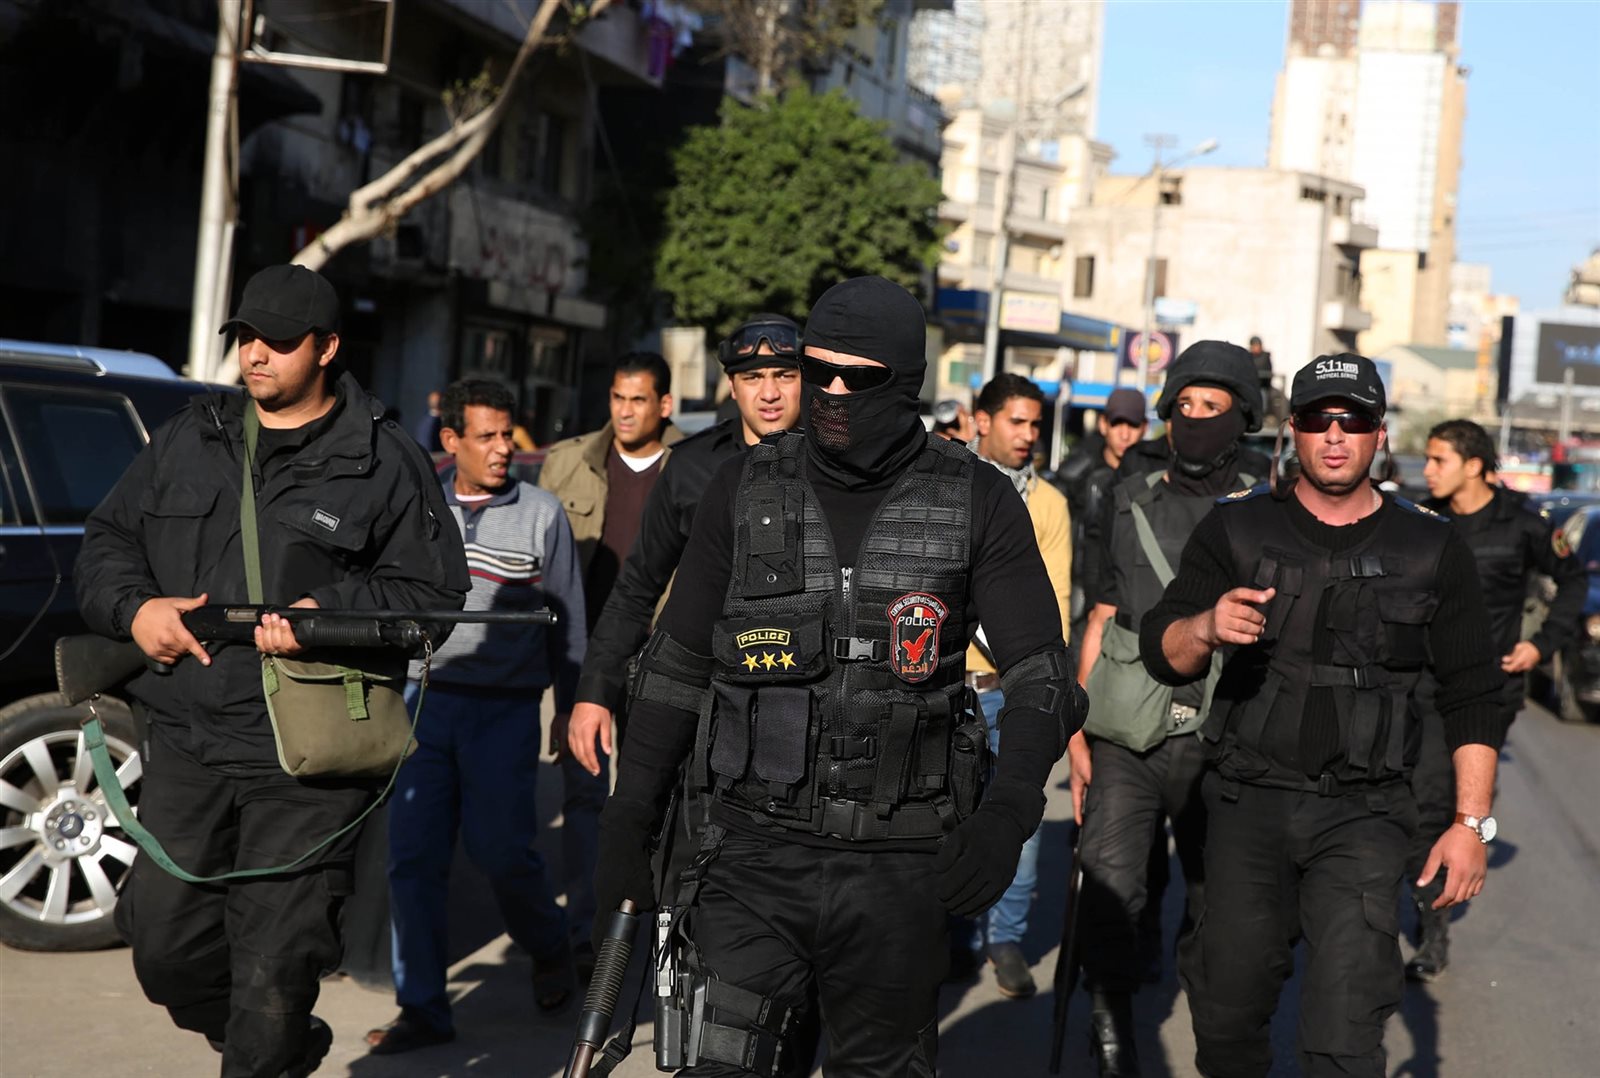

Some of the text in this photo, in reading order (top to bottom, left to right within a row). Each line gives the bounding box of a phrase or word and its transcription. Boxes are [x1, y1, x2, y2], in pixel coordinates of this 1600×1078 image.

[1315, 360, 1343, 374] 5.11
[896, 616, 937, 627] POLICE
[740, 631, 786, 645] POLICE
